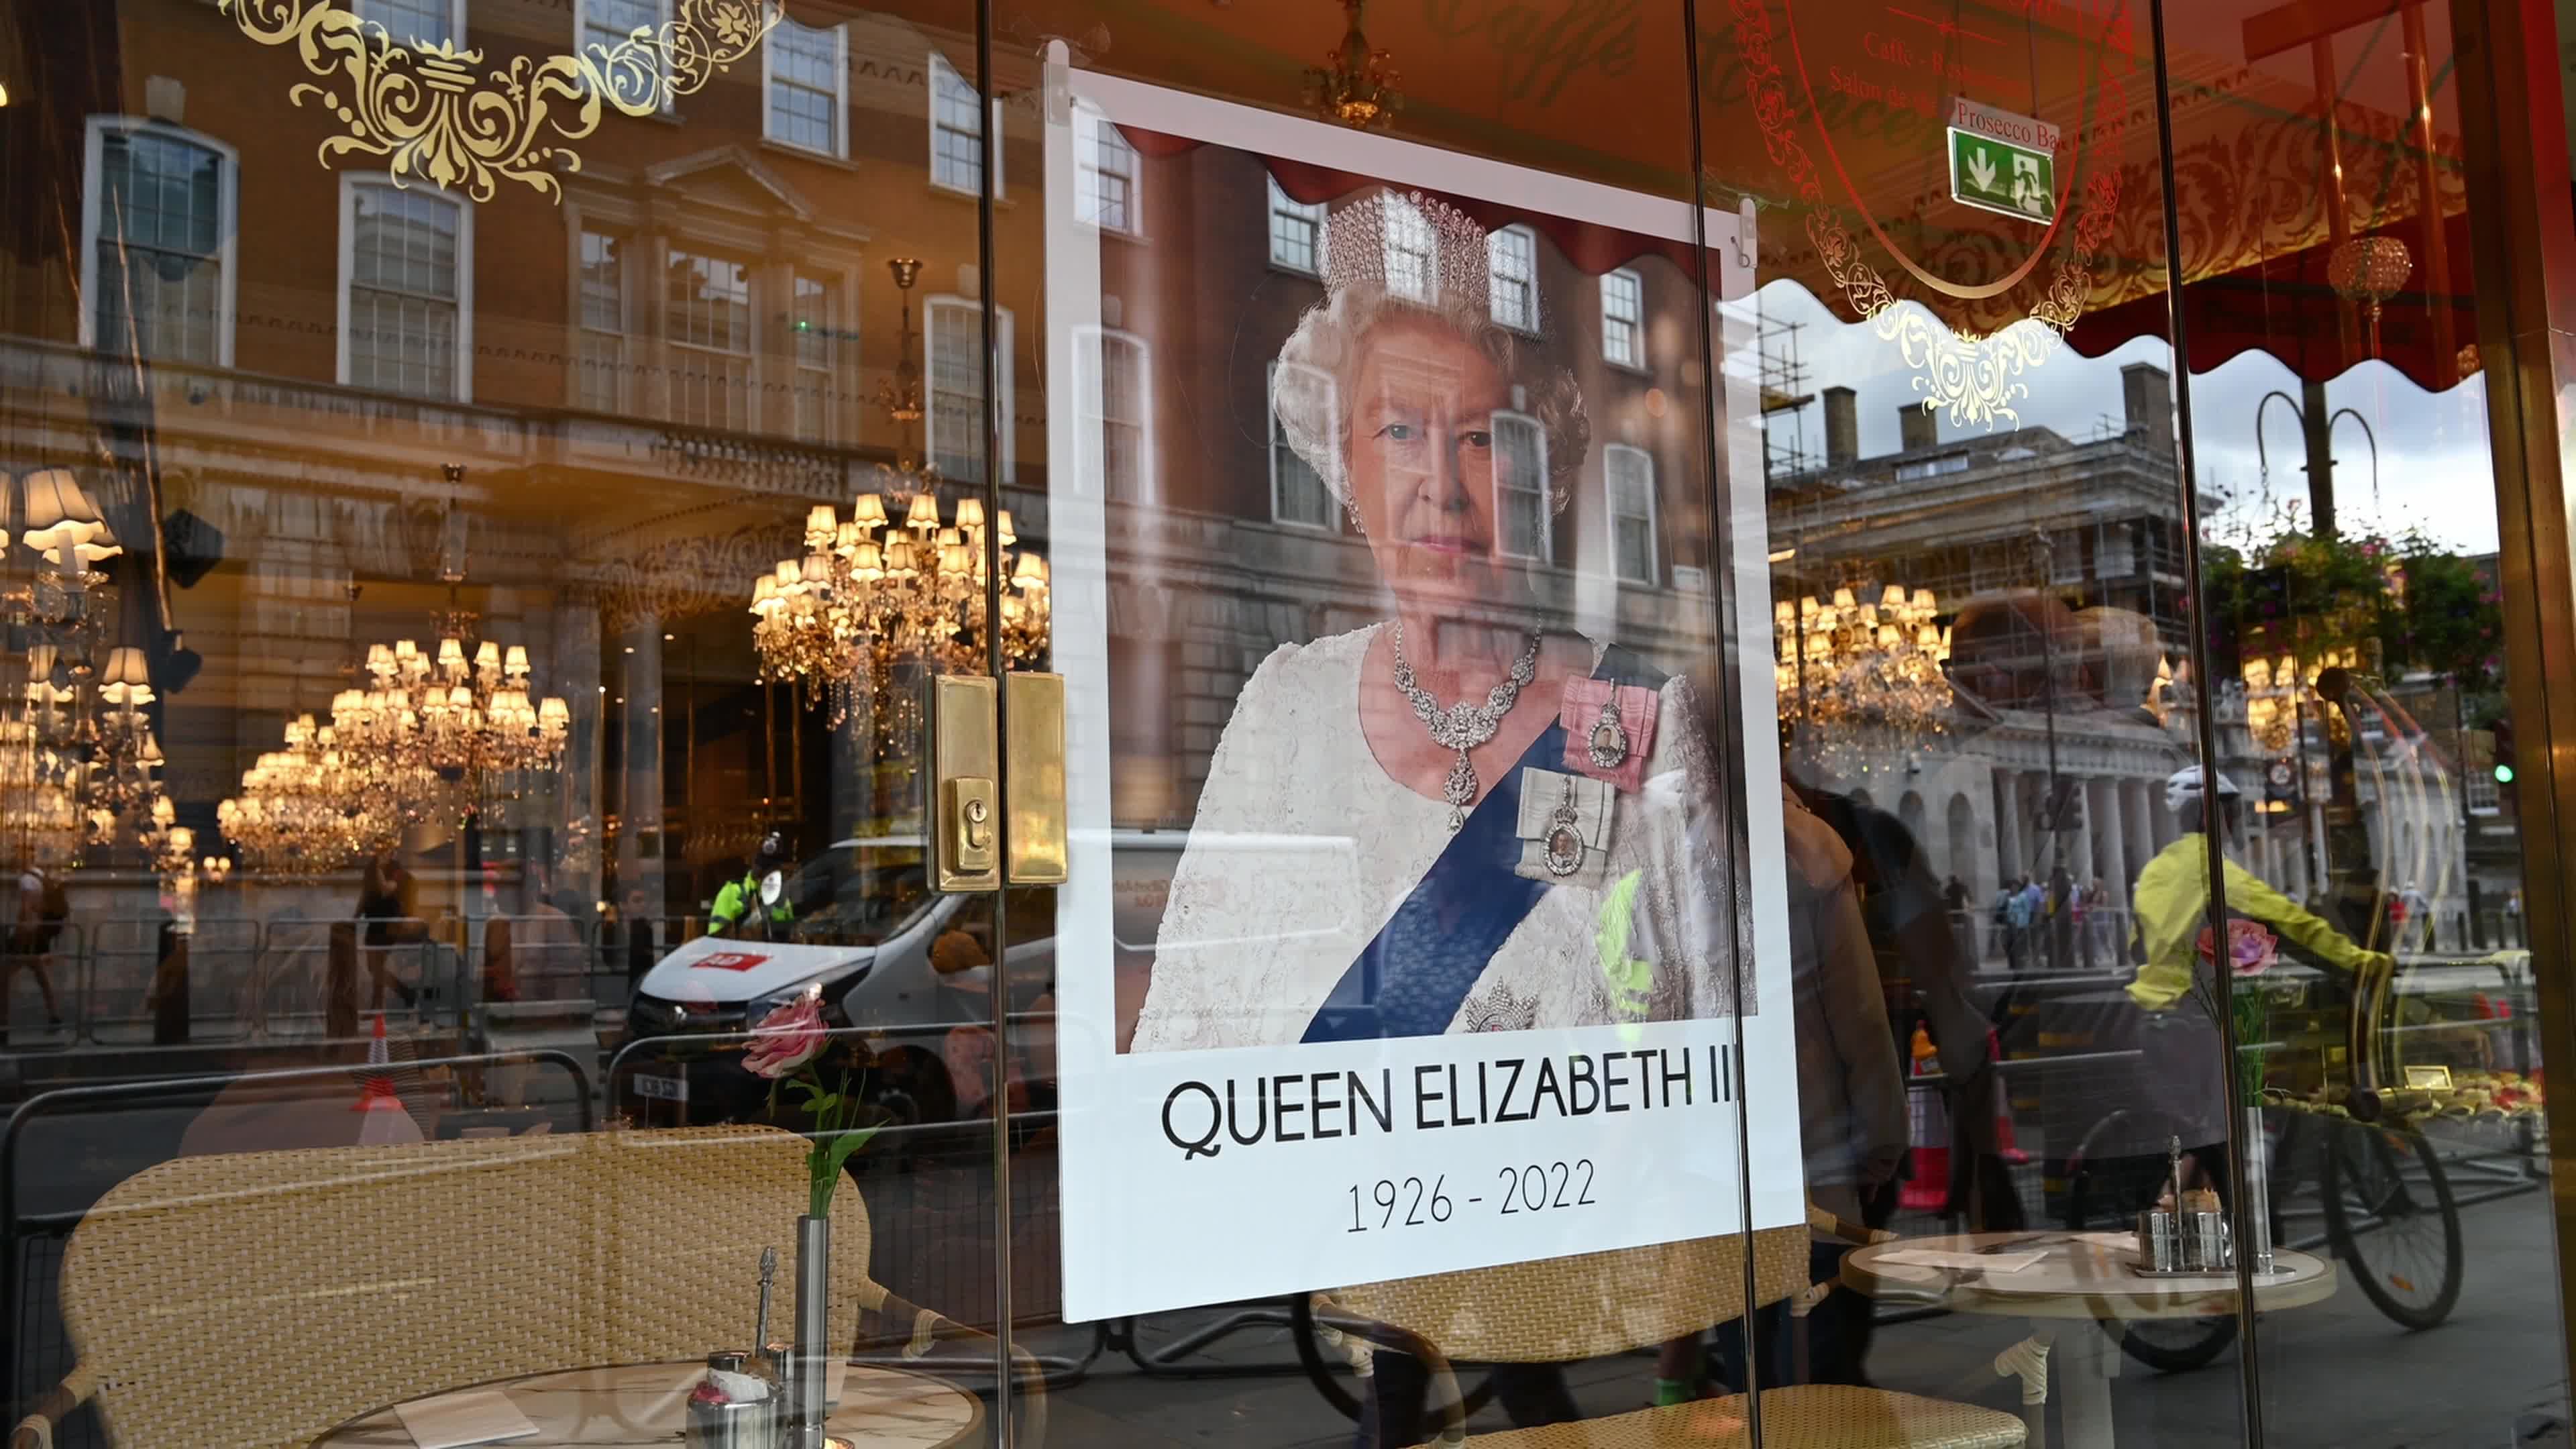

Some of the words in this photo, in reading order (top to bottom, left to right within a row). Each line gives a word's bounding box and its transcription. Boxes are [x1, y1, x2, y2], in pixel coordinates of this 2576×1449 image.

[1829, 66, 1880, 99] Salon
[1957, 102, 2031, 144] Prosecco
[1161, 1068, 1393, 1161] QUEEN
[1414, 1047, 1693, 1130] ELIZABETH
[1709, 1044, 1731, 1104] II
[1347, 1173, 1453, 1234] 1926
[1498, 1158, 1596, 1216] 2022
